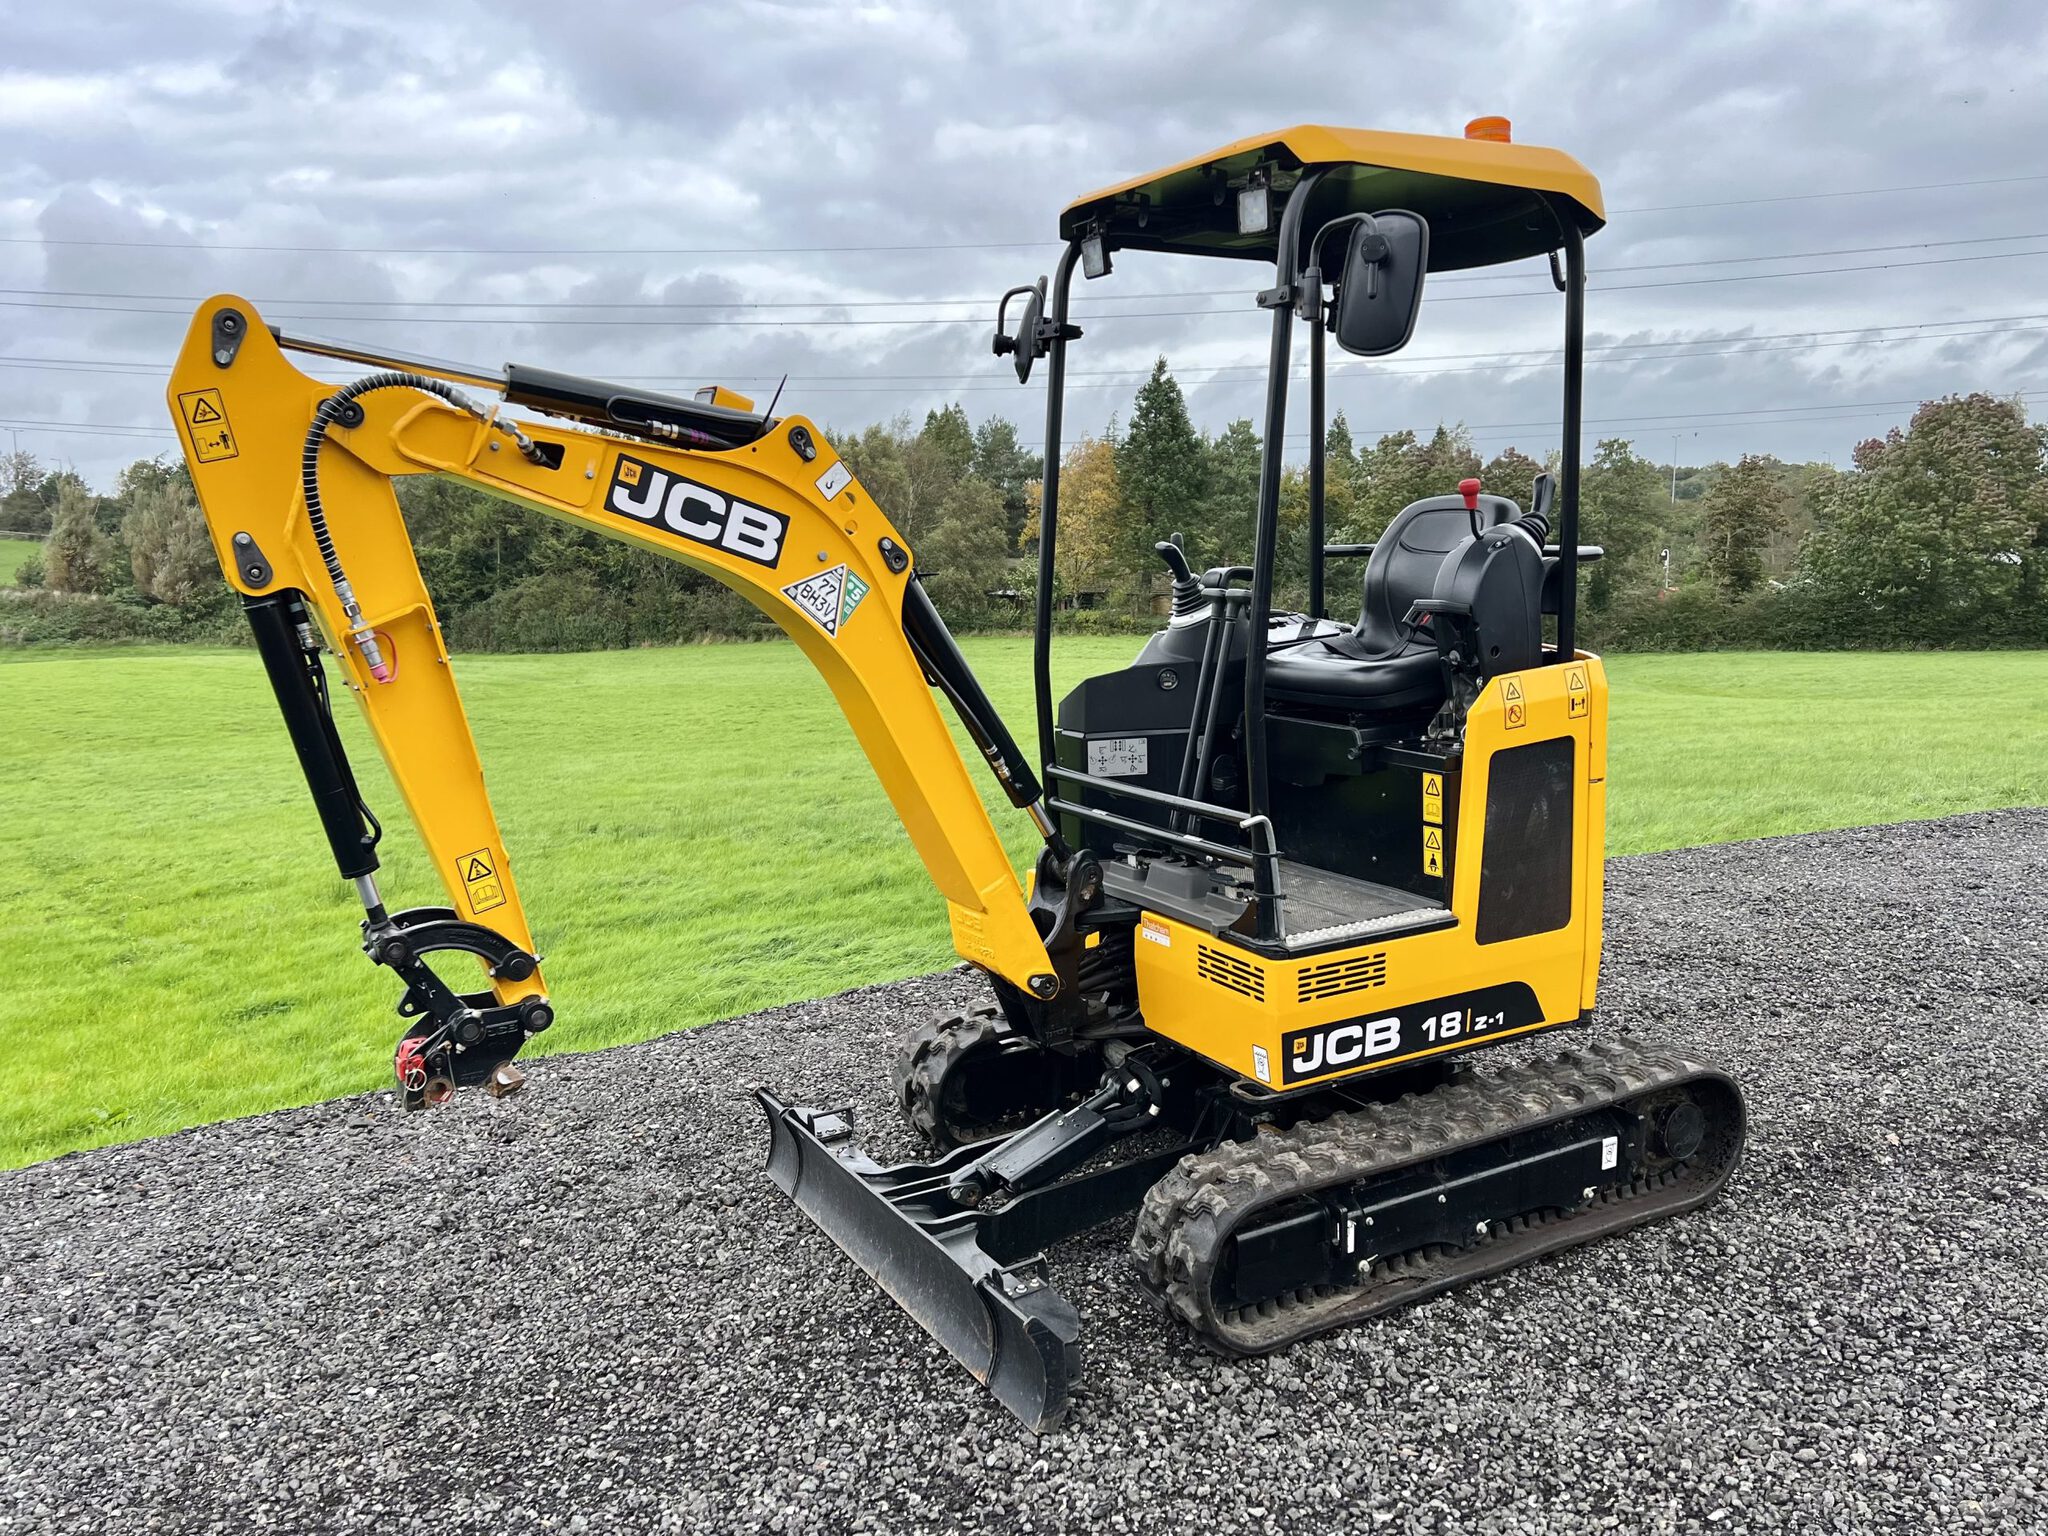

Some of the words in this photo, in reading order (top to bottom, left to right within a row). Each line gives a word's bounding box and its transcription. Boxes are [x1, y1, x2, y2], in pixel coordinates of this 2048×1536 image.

[612, 471, 782, 561] JCB
[800, 584, 836, 617] BH3V
[819, 578, 837, 596] 77
[851, 588, 863, 601] 5
[1292, 1016, 1401, 1074] JCB
[1421, 1010, 1462, 1041] 18
